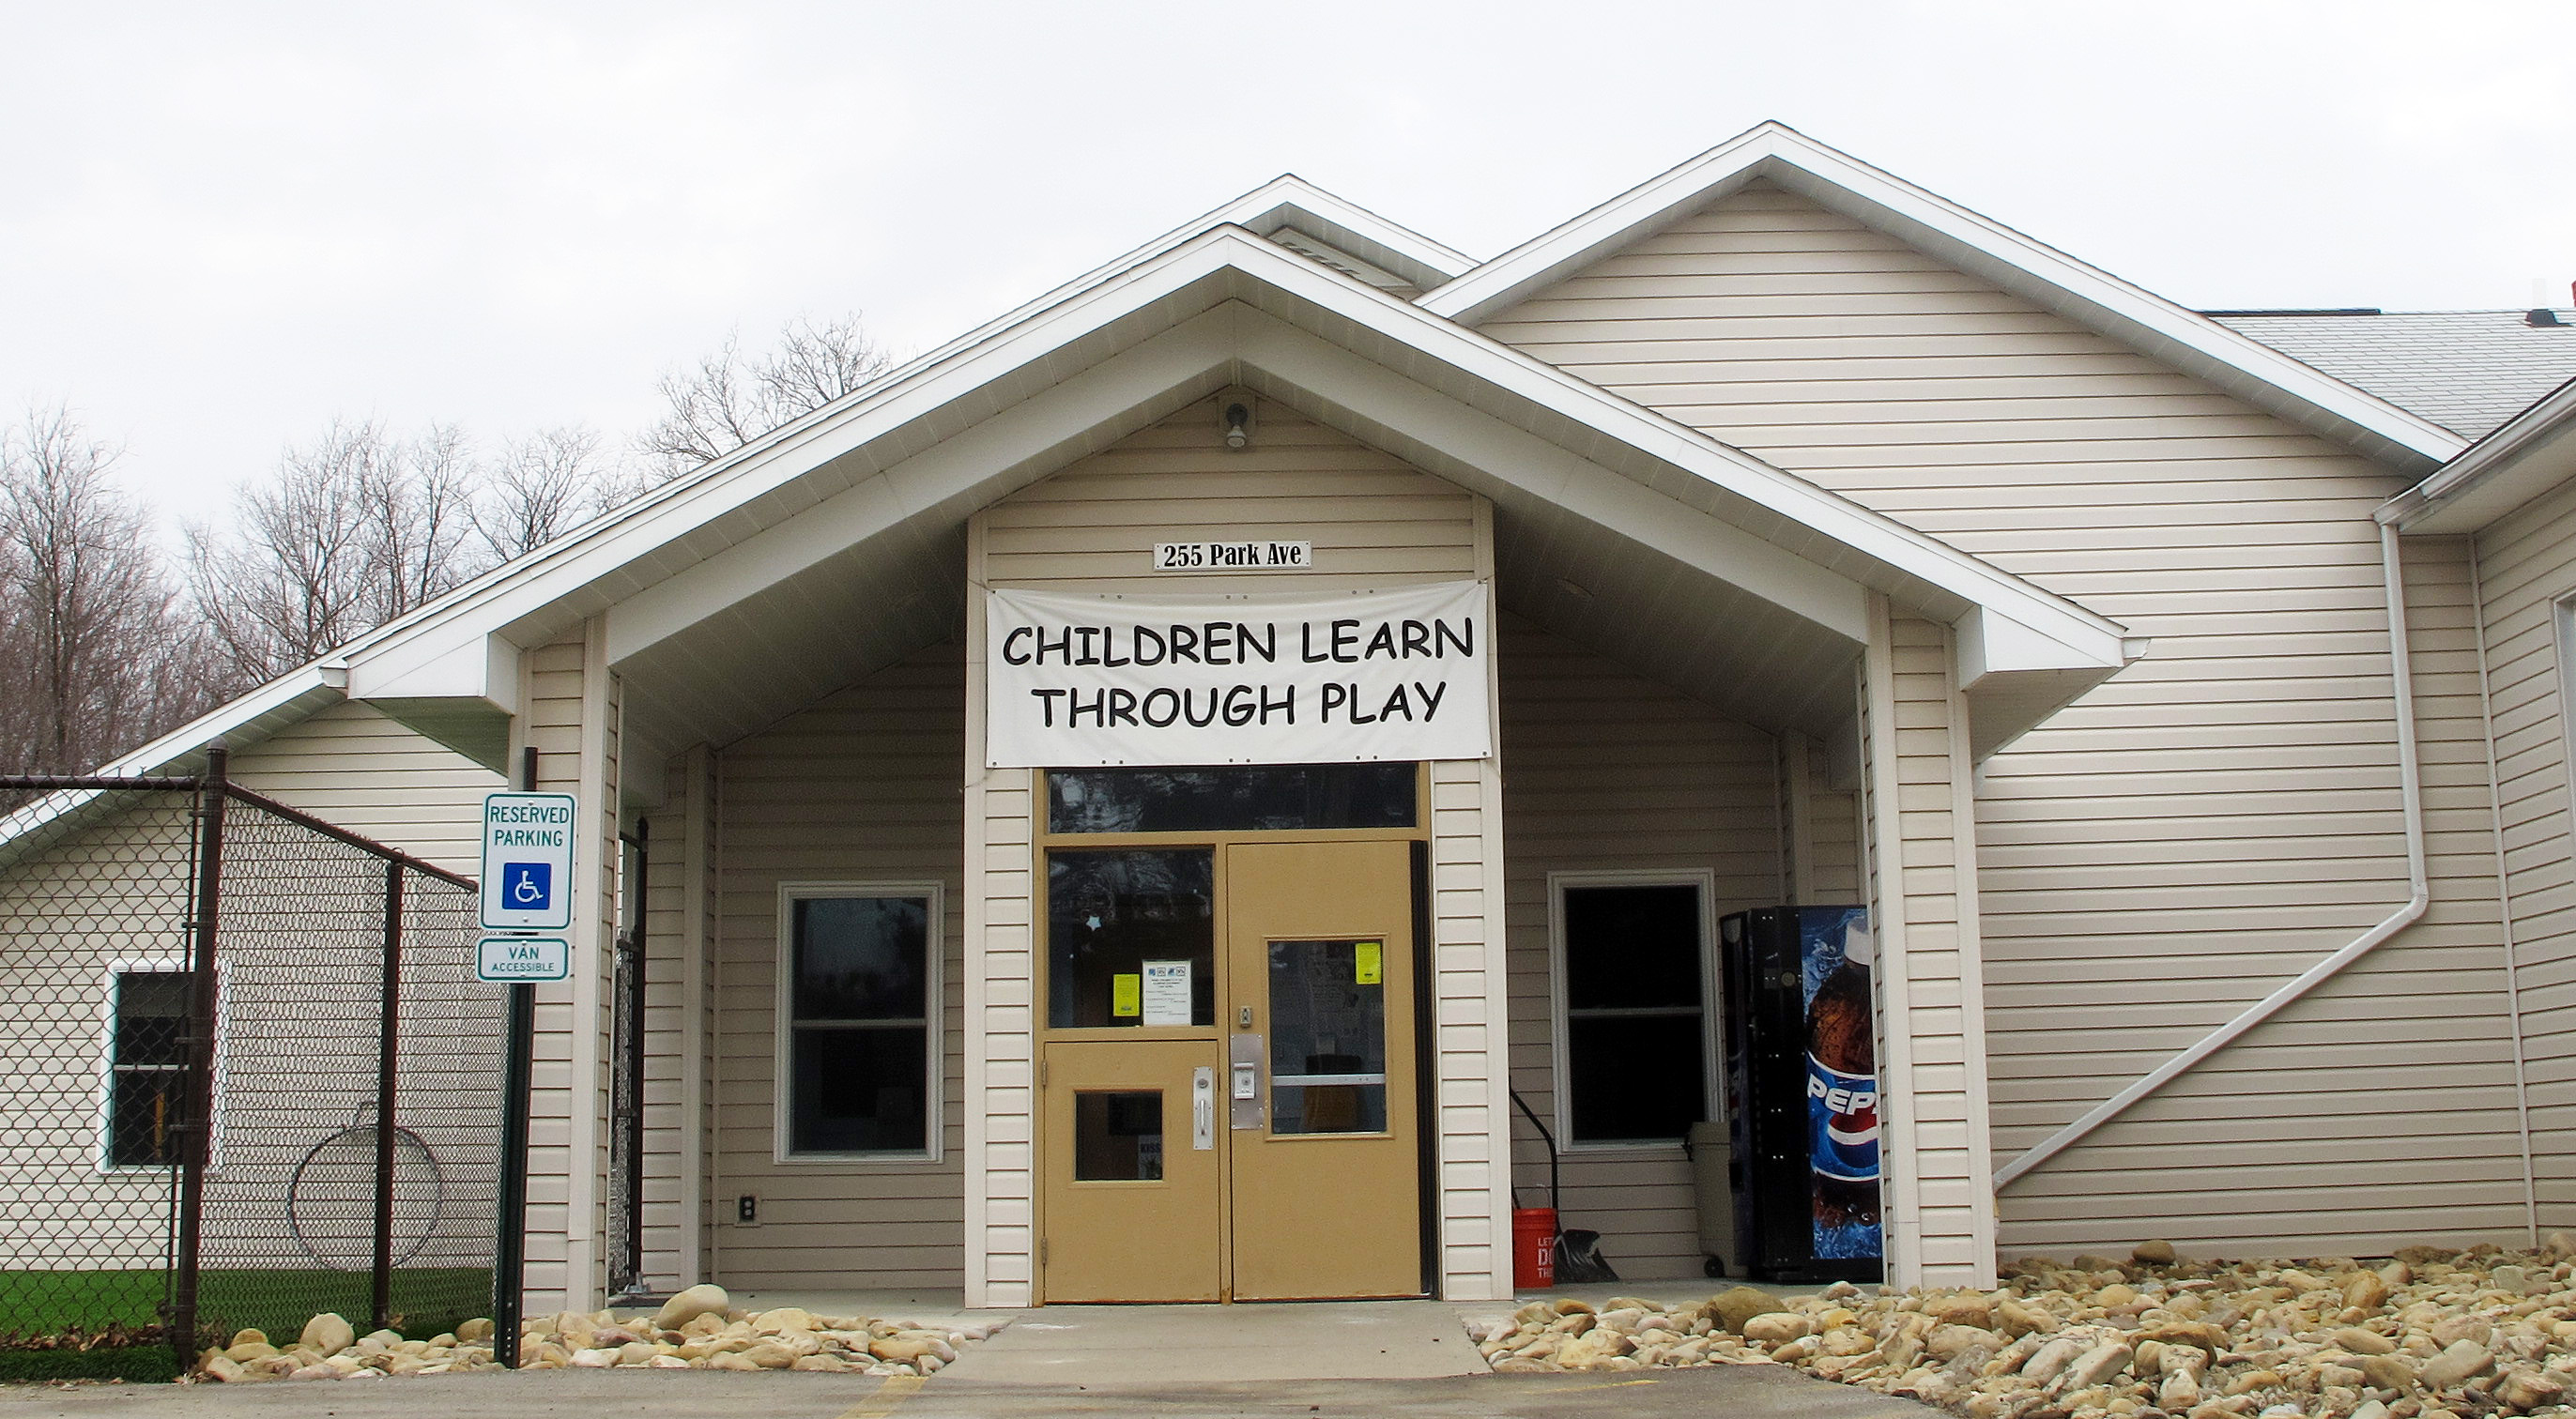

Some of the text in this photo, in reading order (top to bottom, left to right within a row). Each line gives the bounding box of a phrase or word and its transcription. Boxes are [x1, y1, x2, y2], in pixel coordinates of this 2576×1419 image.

[1163, 542, 1302, 567] 255 Park Ave
[1003, 617, 1473, 667] CHILDREN LEARN
[1031, 681, 1447, 727] THROUGH PLAY
[490, 806, 570, 824] RESERVED
[494, 830, 563, 847] PARKING
[508, 946, 540, 960] VAN
[491, 963, 555, 972] ACCESSIBLE
[1807, 1072, 1878, 1116] PEP
